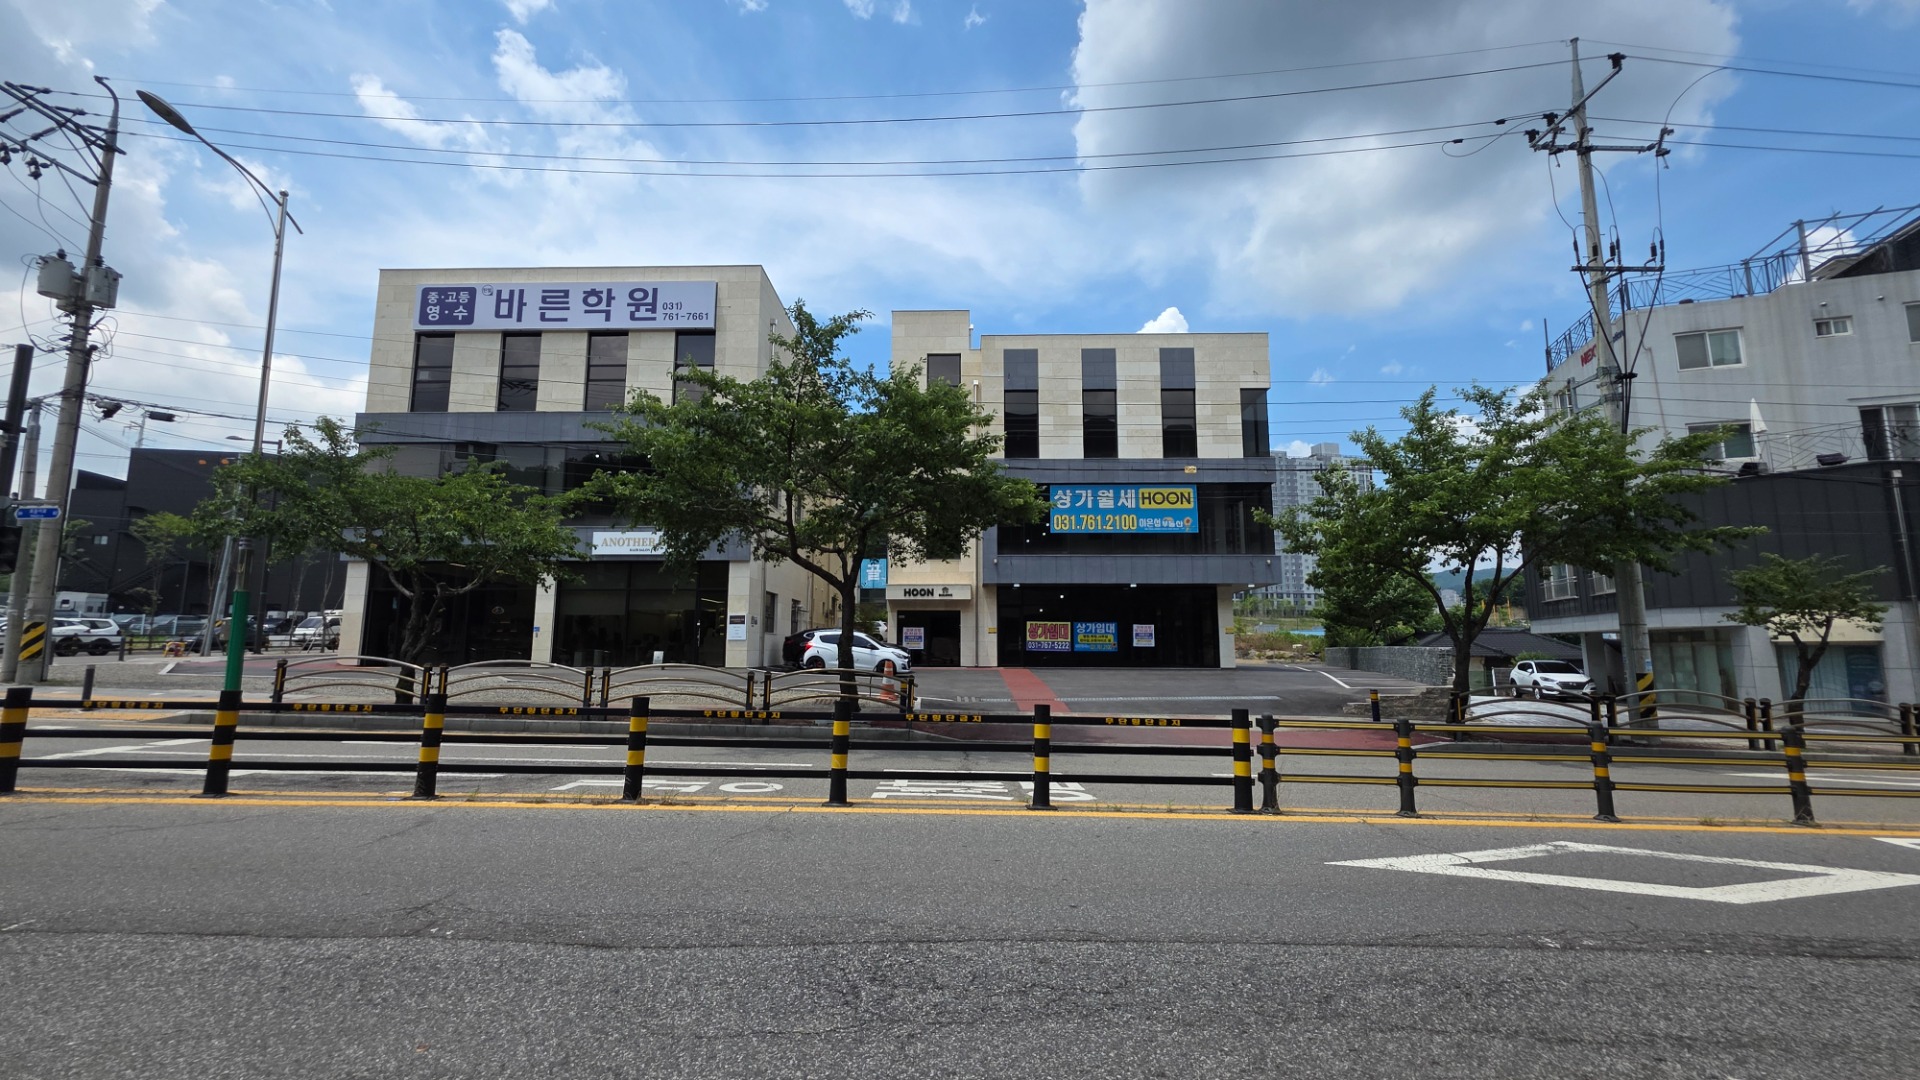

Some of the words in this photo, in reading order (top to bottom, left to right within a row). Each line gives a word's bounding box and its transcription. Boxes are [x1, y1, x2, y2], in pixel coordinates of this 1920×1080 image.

[427, 291, 470, 304] 중·고등
[494, 287, 659, 323] 바른학원
[662, 301, 683, 311] 031)
[426, 305, 469, 321] 영·수
[662, 312, 710, 321] 761-7661
[1053, 489, 1136, 509] 상가월세
[1141, 491, 1191, 505] HOON
[1053, 514, 1137, 530] 031.761.2100
[601, 537, 656, 547] ANOTHER
[903, 588, 934, 597] HOON
[1028, 623, 1070, 640] 상가임대
[1076, 623, 1115, 634] 상가임대
[1028, 641, 1070, 649] 031-767-5222
